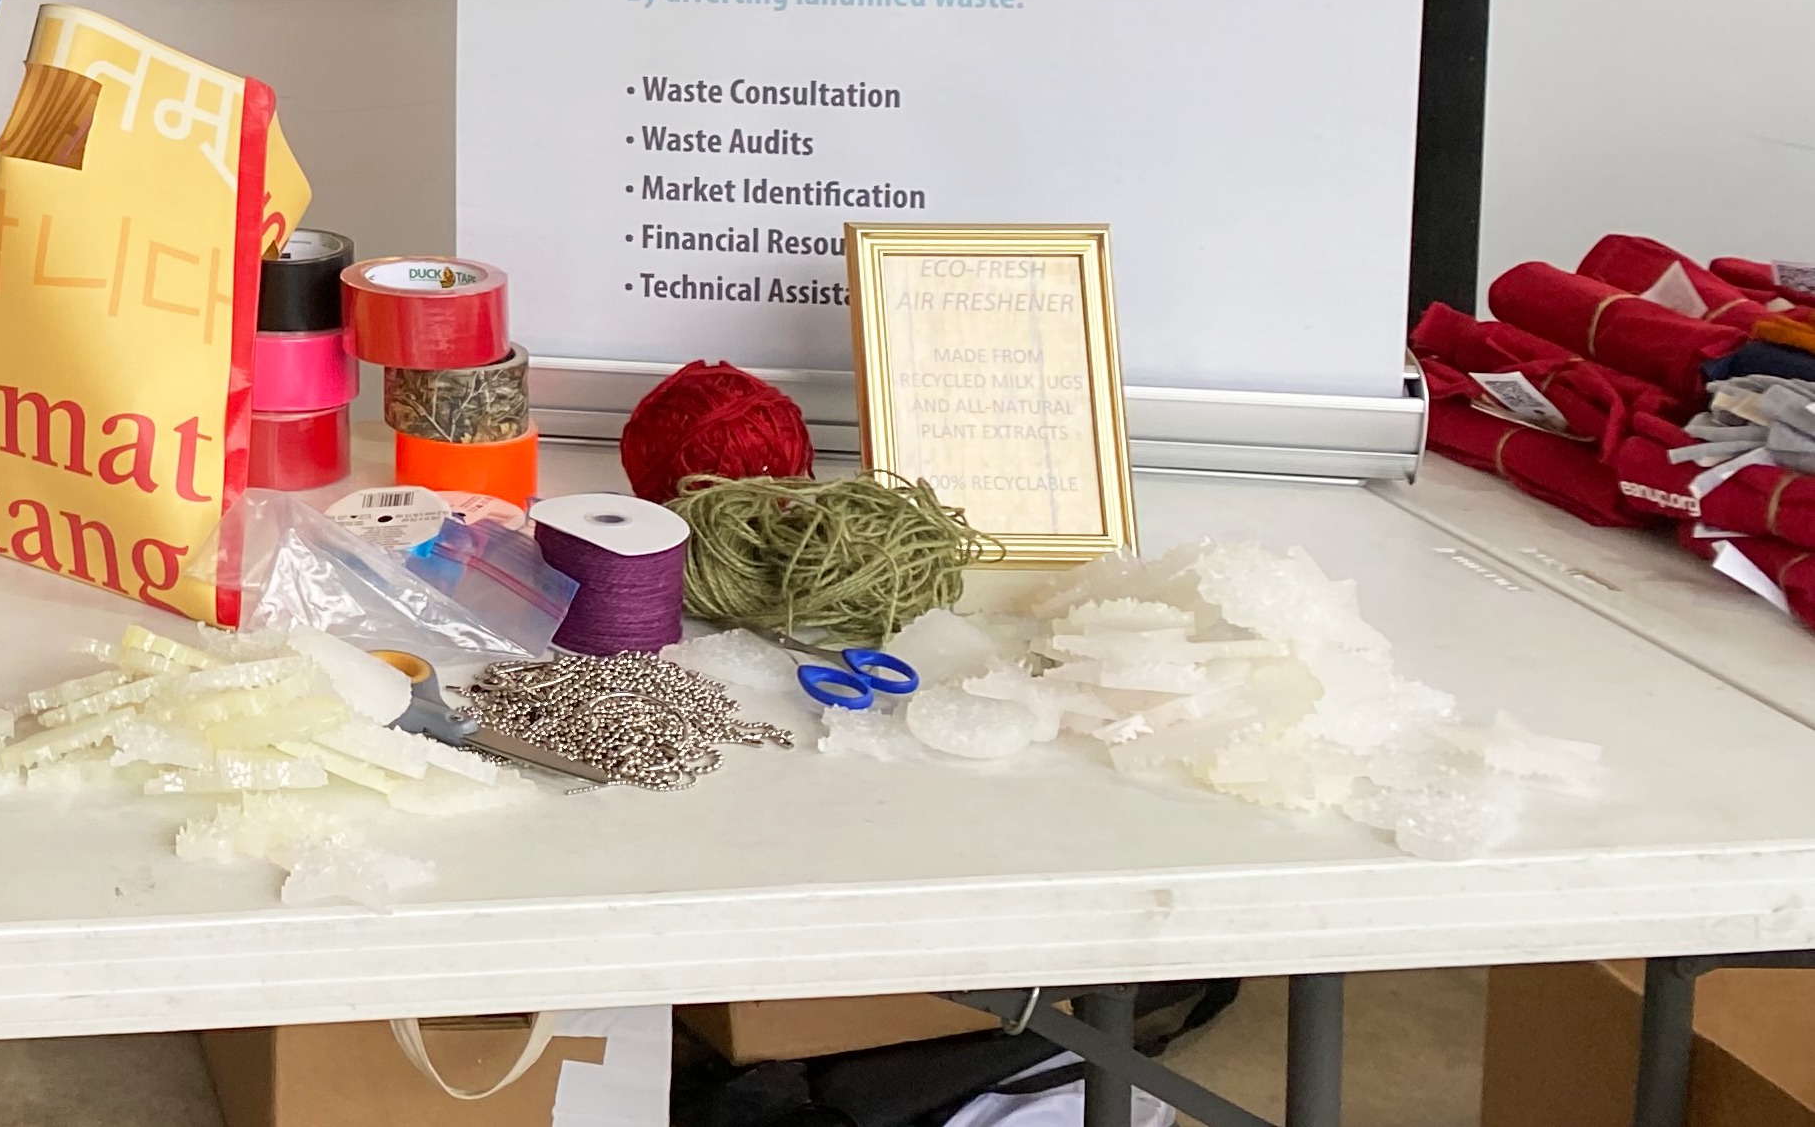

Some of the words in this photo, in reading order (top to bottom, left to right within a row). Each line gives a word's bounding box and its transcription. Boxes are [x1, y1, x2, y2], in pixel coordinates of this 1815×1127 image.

[642, 76, 722, 103] Waste
[730, 79, 900, 108] Consultation
[642, 125, 721, 153] Waste
[729, 128, 814, 155] Audits
[641, 175, 735, 202] Market
[743, 178, 926, 209] Identification
[642, 224, 759, 253] Financial
[768, 228, 845, 256] Resou
[409, 268, 441, 279] DUCK
[921, 259, 1046, 279] ECO-FRESH
[640, 273, 760, 302] Technical
[896, 292, 934, 311] AIR
[942, 293, 1074, 313] FRESHENER
[935, 348, 987, 363] MADE
[993, 349, 1044, 363] FROM
[900, 373, 986, 388] RECYCLED
[992, 375, 1035, 389] MILK
[1043, 375, 1083, 390] UGS
[912, 398, 950, 413] AND
[955, 399, 1074, 415] ALL-NATURAL
[921, 424, 976, 439] PLANT
[983, 425, 1068, 440] EXTRACTS
[929, 475, 967, 490] 00%
[972, 476, 1079, 491] RECYCLABLE
